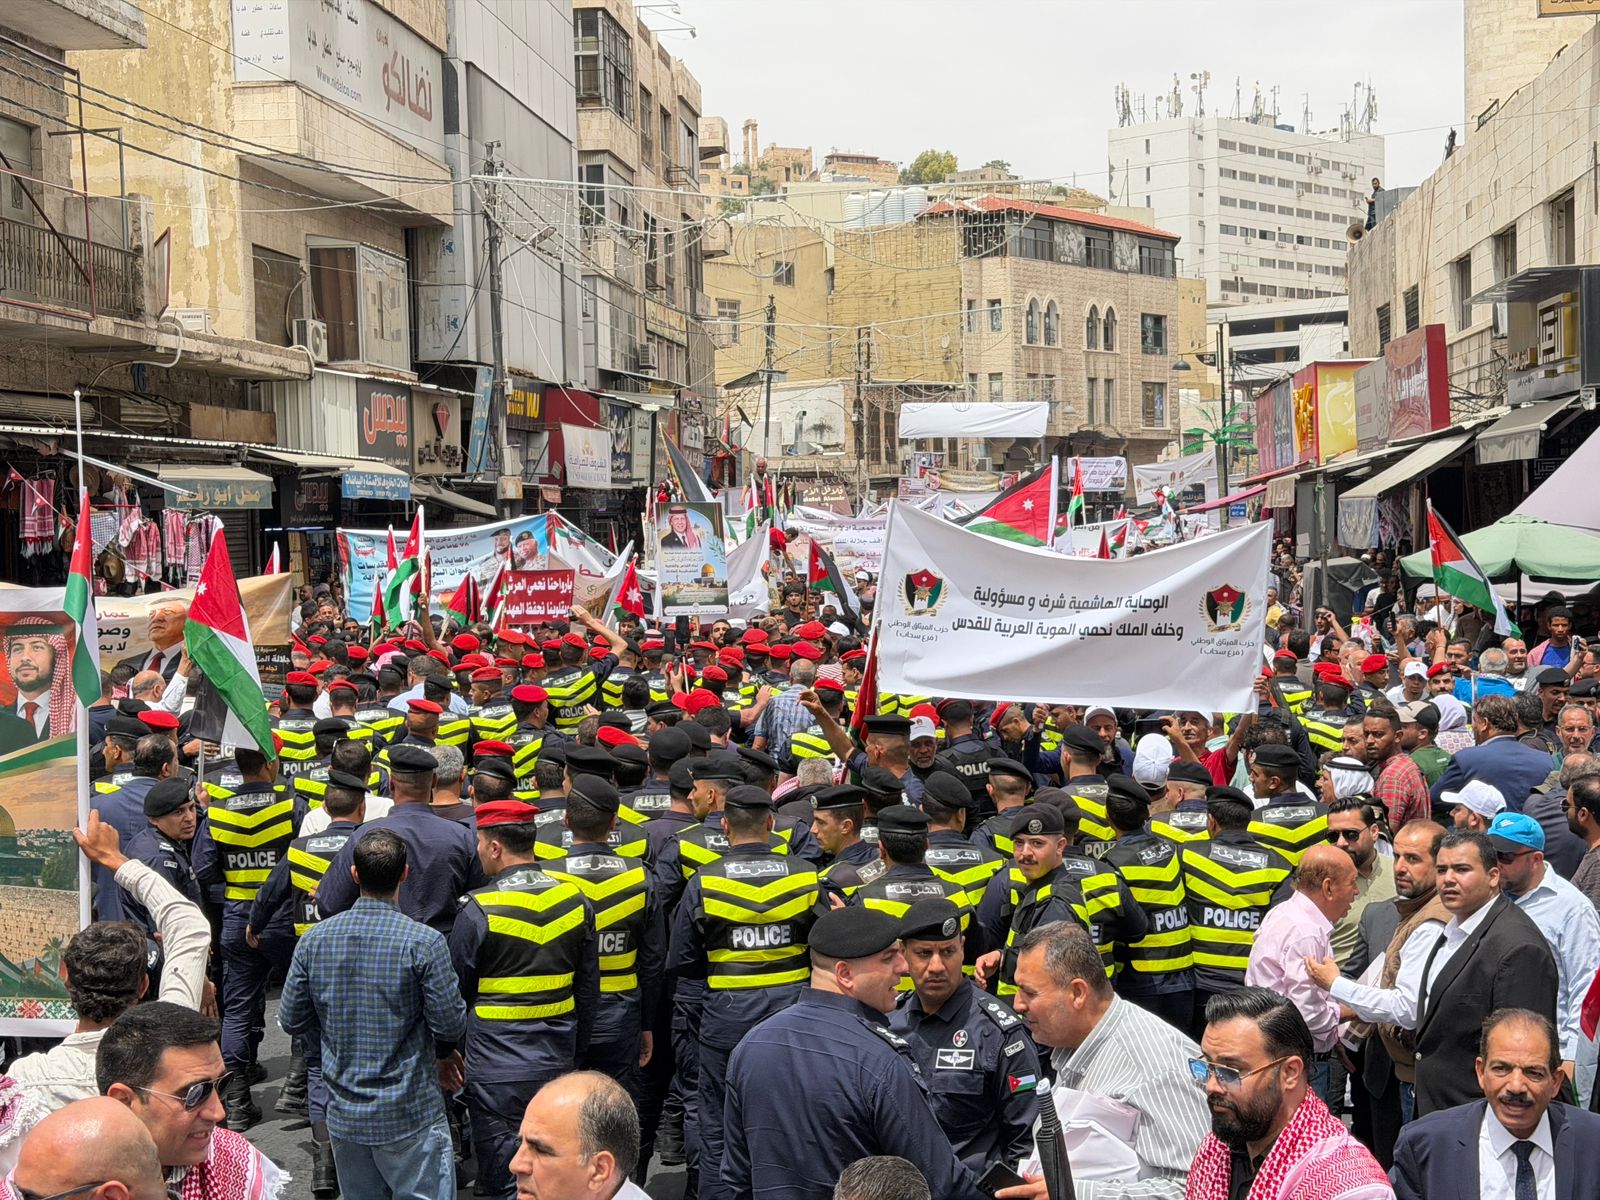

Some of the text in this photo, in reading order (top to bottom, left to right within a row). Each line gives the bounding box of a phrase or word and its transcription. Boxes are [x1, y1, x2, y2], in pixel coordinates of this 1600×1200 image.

[527, 577, 546, 596] نحمي
[548, 574, 573, 594] بأرواحنا
[973, 586, 1169, 613] الوصاية الهاشمية شرف و مسؤولية
[525, 602, 546, 615] نحفظ
[887, 619, 911, 630] الوطني
[911, 622, 933, 632] الميثاق
[952, 616, 1184, 641] وخلف الملك نحمي الهوية العربية للقدس
[1190, 636, 1255, 648] حزب الميثاق الوطني
[271, 655, 290, 665] جلالة
[560, 706, 584, 718] POLIC
[1264, 807, 1315, 821] الشرطة
[228, 850, 276, 868] POLICE
[926, 850, 980, 862] الشرطة
[568, 858, 624, 871] الشرطة
[727, 863, 785, 876] الشرطة
[887, 886, 942, 897] الشرطة
[1155, 908, 1189, 932] POLIC
[1203, 907, 1261, 930] POLICE
[598, 932, 626, 953] ICE
[732, 924, 792, 948] POLICE
